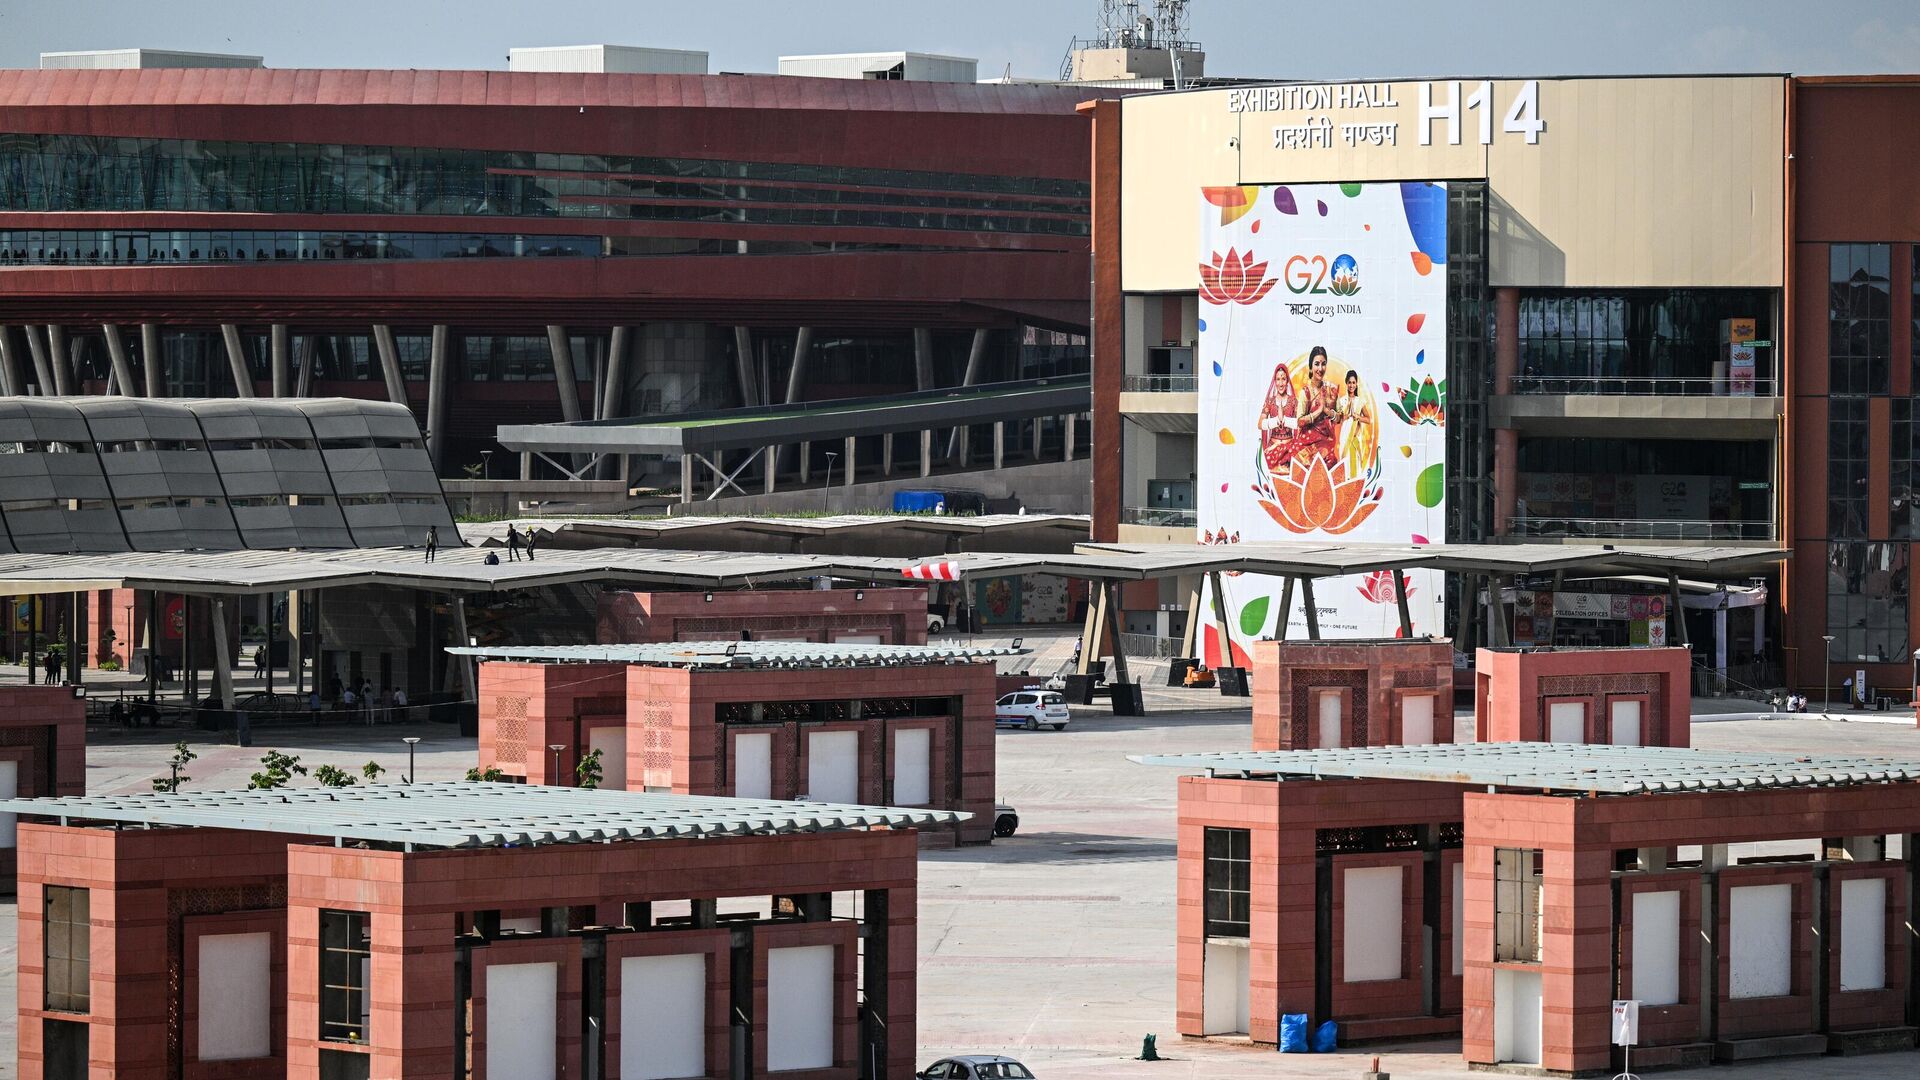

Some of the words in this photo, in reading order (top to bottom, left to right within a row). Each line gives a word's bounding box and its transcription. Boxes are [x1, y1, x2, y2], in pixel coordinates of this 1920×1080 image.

[1228, 85, 1333, 113] EXHIBITION
[1338, 83, 1399, 109] HALL
[1419, 81, 1546, 145] H14
[1340, 123, 1399, 148] मण्डप
[1284, 253, 1362, 297] G20
[1314, 305, 1335, 317] 2023
[1337, 304, 1362, 314] INDIA
